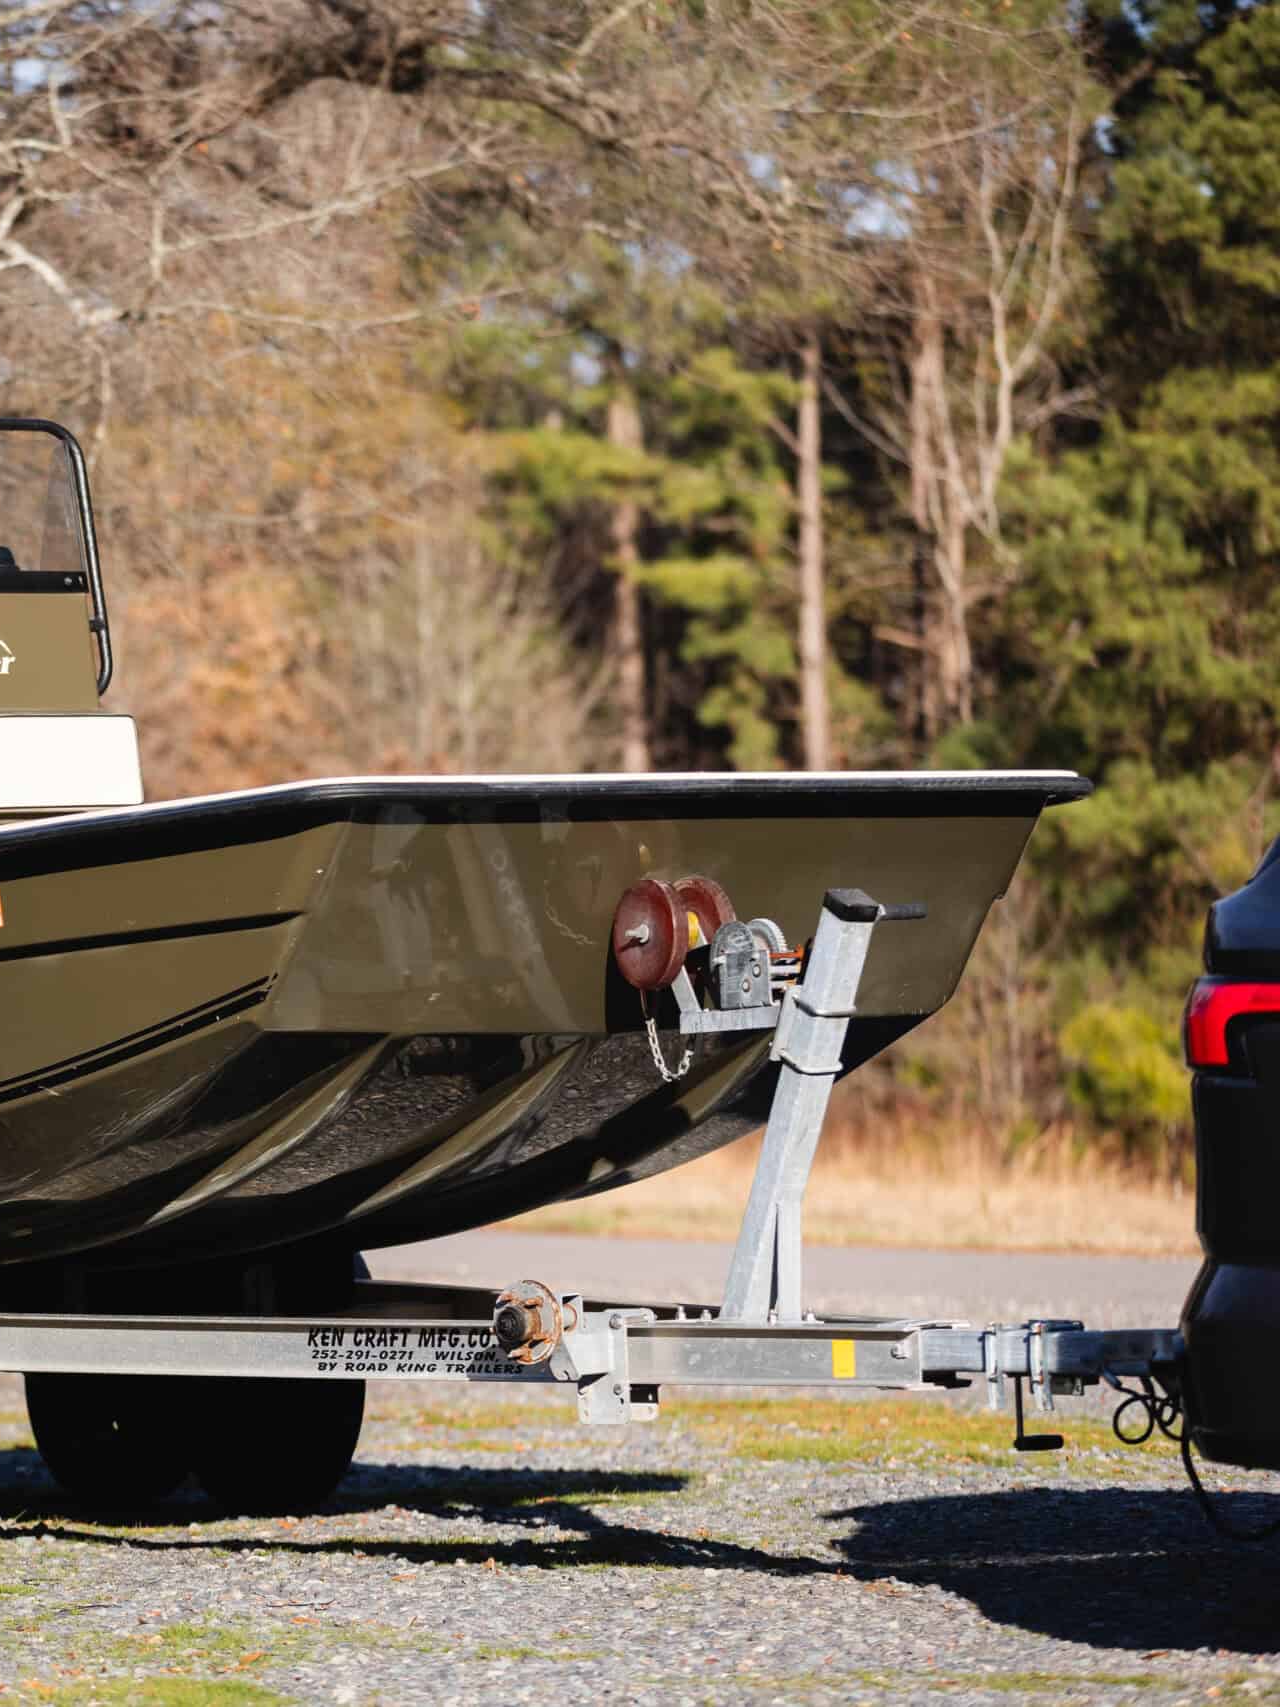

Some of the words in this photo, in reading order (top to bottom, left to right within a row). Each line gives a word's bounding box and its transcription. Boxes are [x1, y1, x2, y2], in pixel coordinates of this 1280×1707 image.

[307, 1327, 344, 1347] KEN
[353, 1327, 411, 1348] CRAFT
[311, 1350, 414, 1360] 252-291-0271
[317, 1362, 338, 1371] BY
[344, 1362, 388, 1372] ROAD
[396, 1363, 437, 1372] KING
[446, 1363, 523, 1373] TRAILERS
